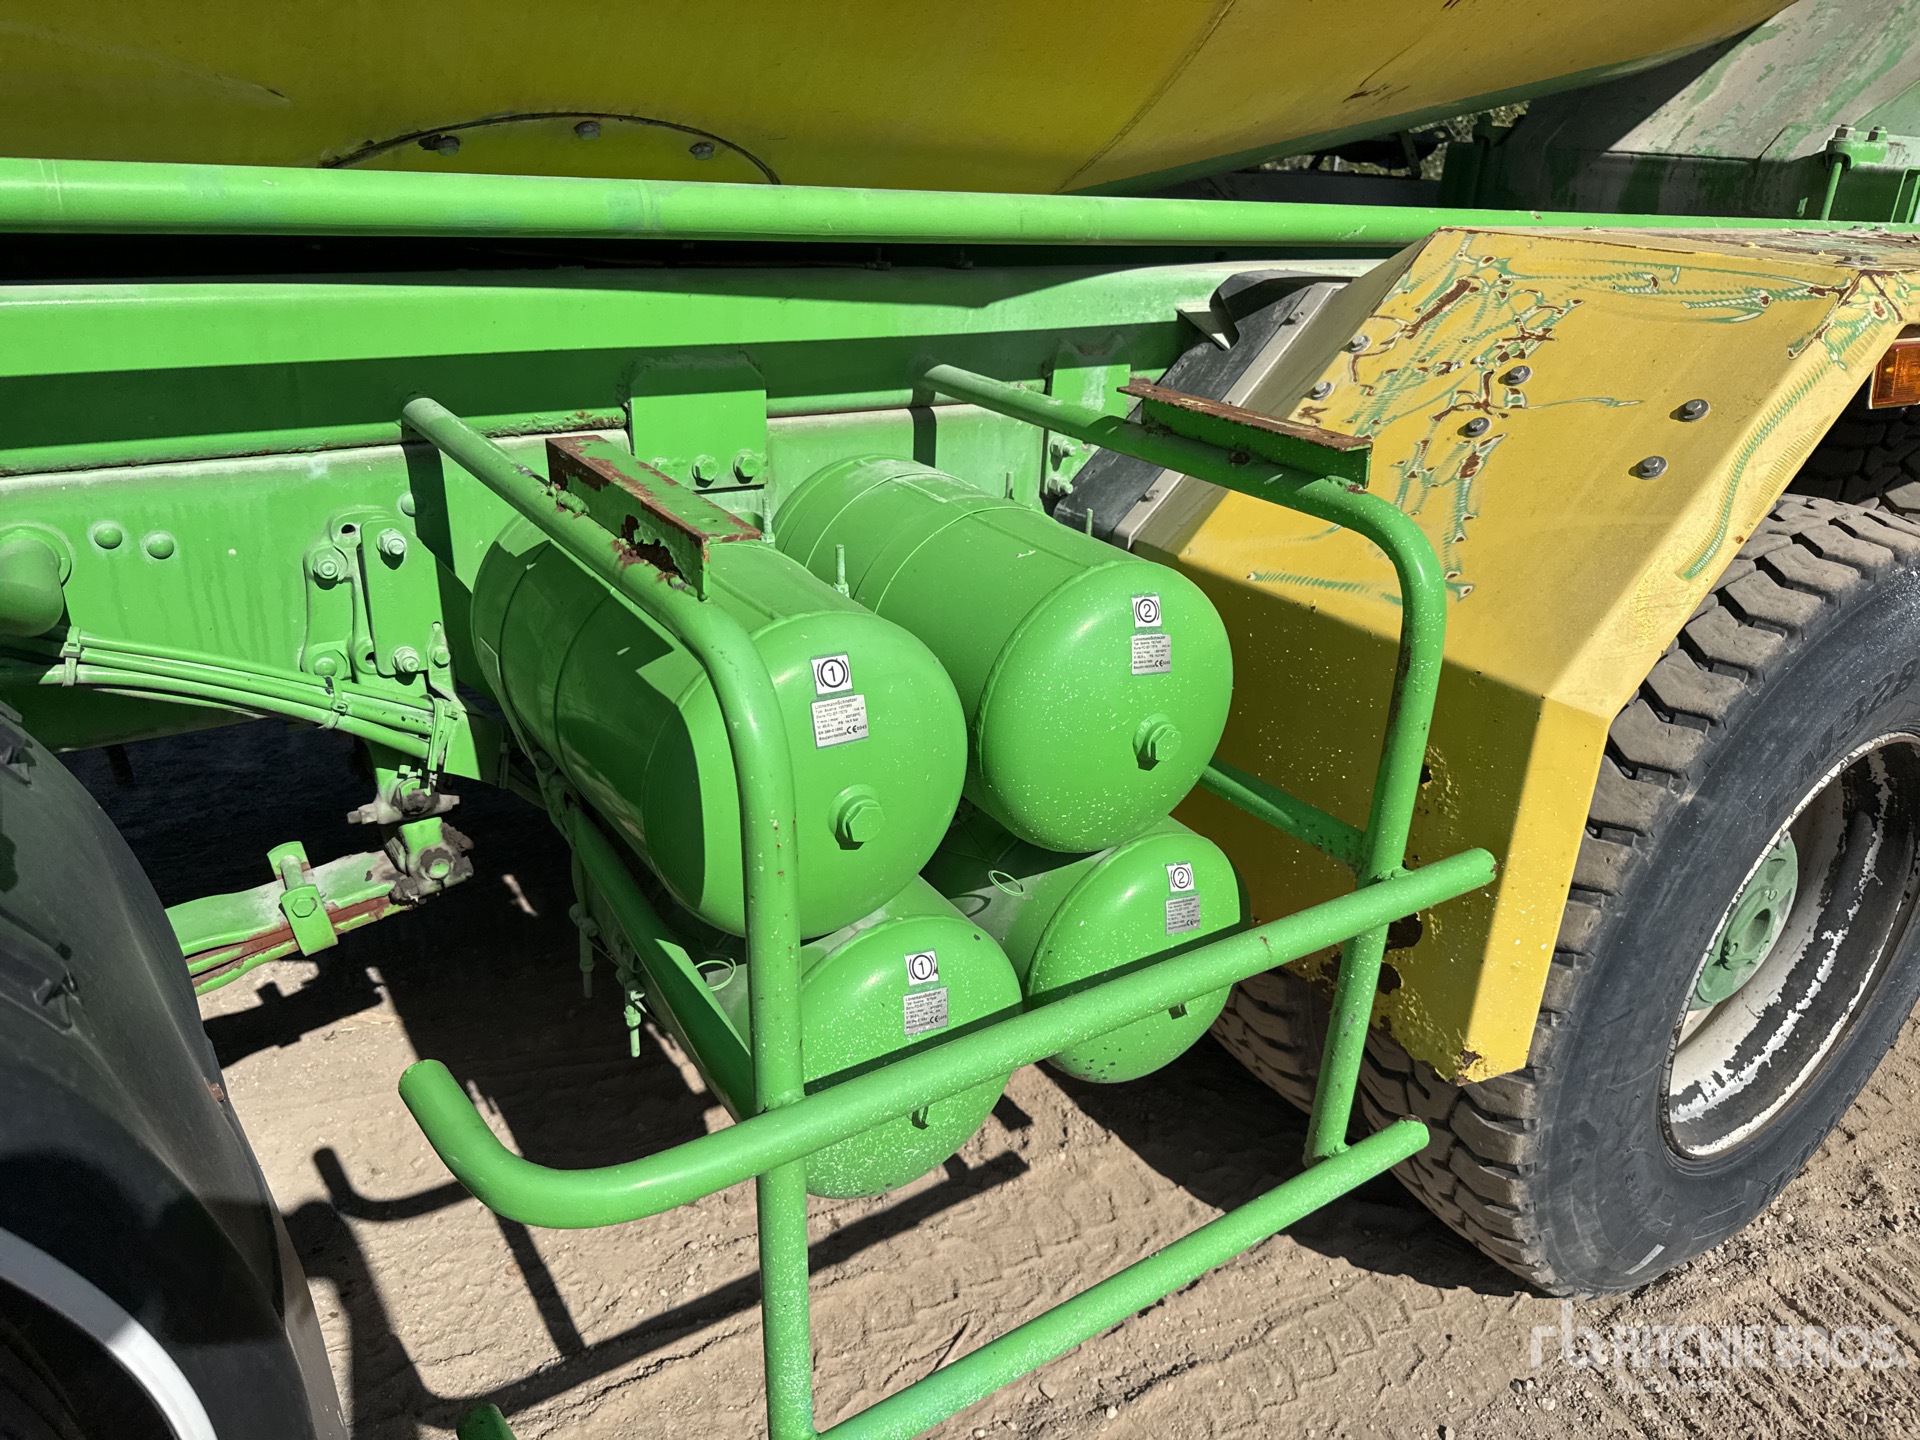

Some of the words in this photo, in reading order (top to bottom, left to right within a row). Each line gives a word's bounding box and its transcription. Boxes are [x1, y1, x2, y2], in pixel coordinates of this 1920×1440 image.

[1143, 603, 1153, 618] 2
[828, 665, 836, 682] 1
[1177, 870, 1185, 884] 2
